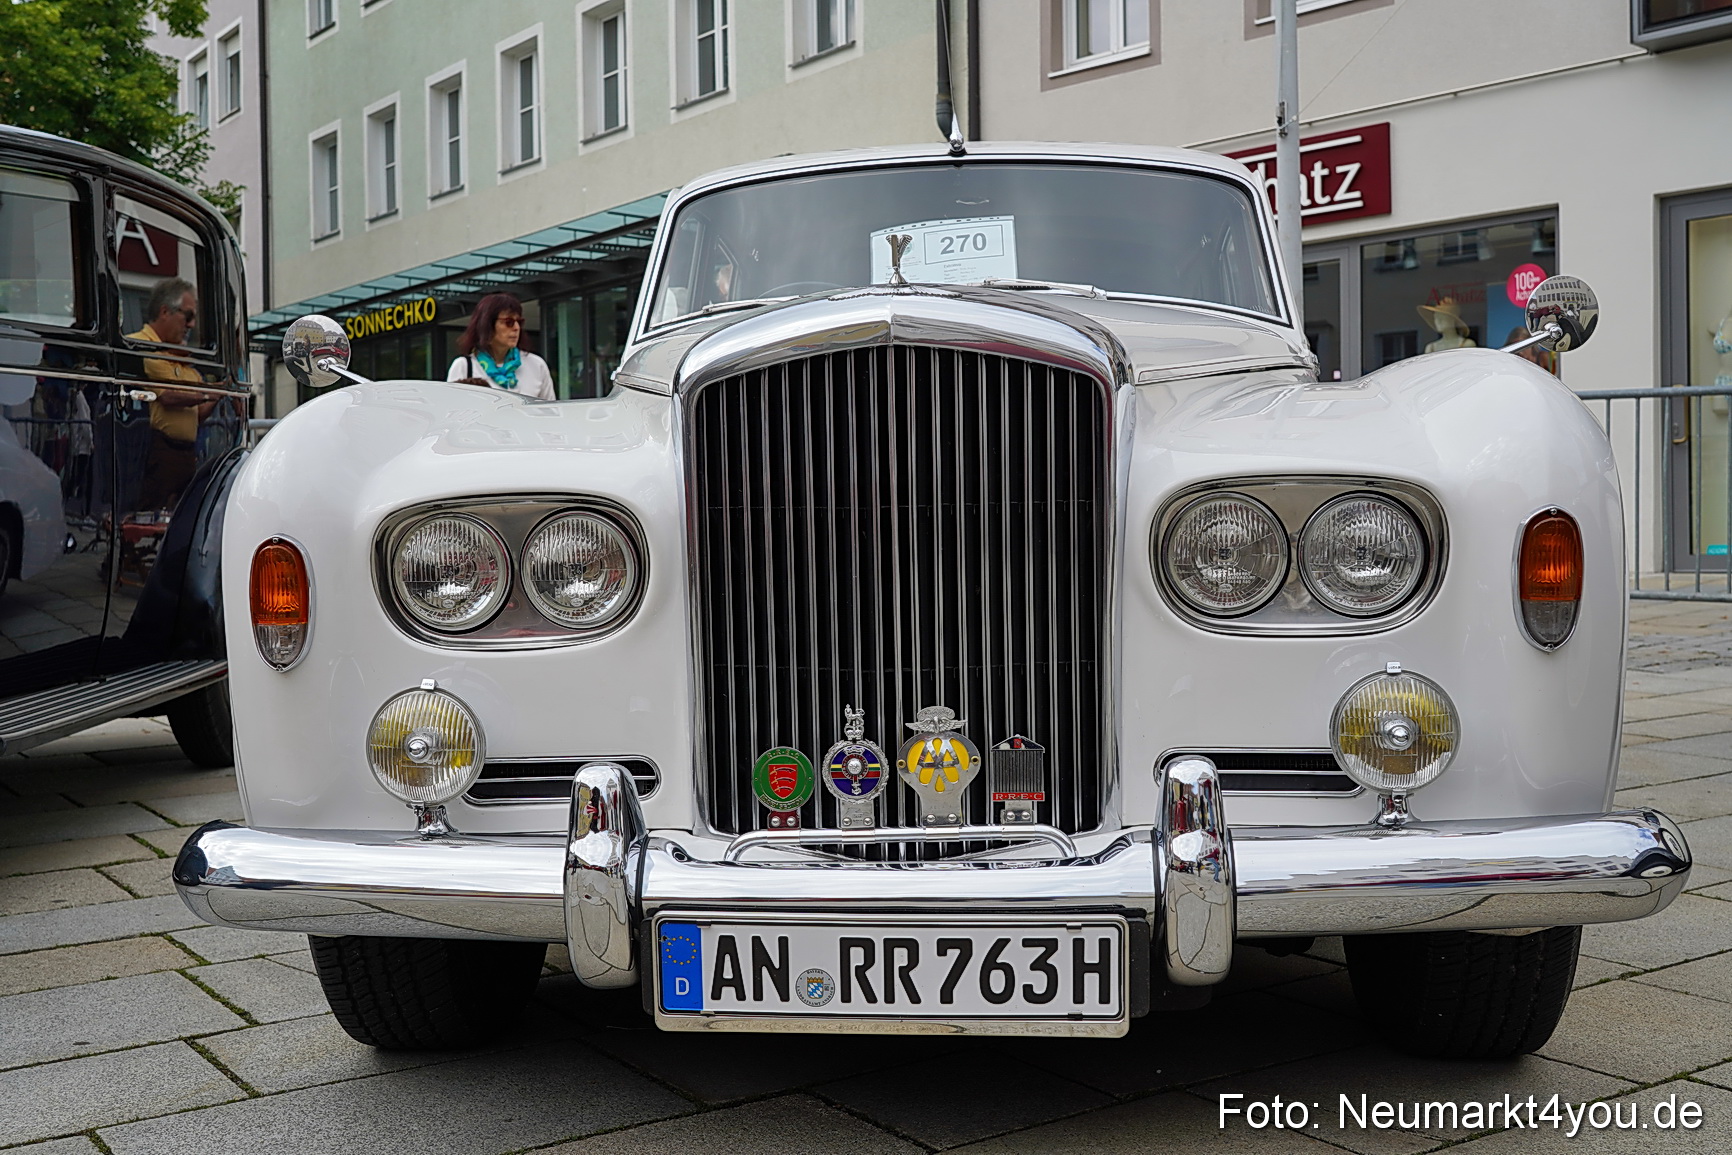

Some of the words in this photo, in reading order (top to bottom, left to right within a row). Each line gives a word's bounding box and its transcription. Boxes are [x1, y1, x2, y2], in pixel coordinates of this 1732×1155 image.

[940, 232, 987, 255] 270
[345, 297, 436, 340] SONNECHKO
[710, 935, 790, 1002] AN
[675, 977, 690, 996] D
